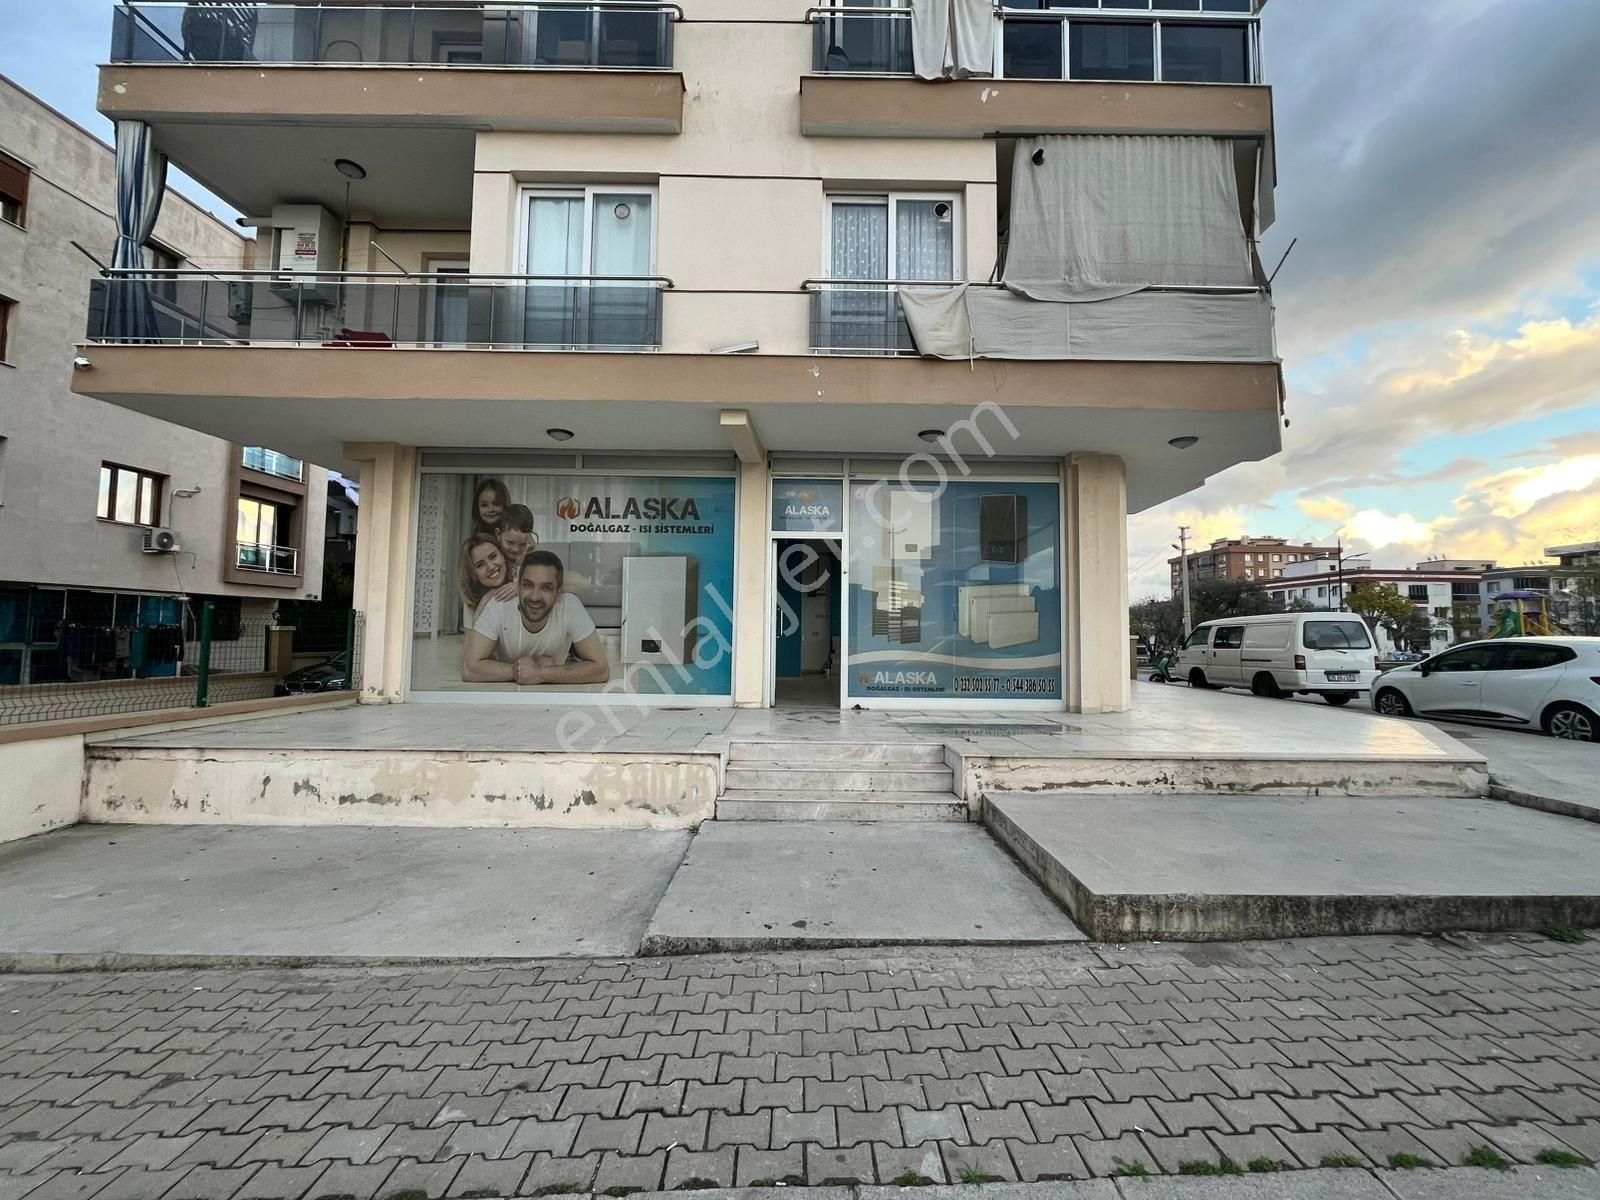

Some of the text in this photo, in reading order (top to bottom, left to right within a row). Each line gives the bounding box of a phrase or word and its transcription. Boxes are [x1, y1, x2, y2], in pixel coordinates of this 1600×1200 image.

[584, 496, 700, 520] ALASKA
[784, 505, 830, 515] ALASKA
[570, 522, 630, 533] DOĞALGAZ
[639, 524, 651, 533] ISI
[654, 523, 714, 534] SİSTEMLERİ
[874, 671, 937, 685] ALASKA
[954, 677, 959, 692] 0
[993, 678, 1000, 692] 77
[1006, 678, 1011, 692] 0
[1013, 678, 1024, 692] 544
[1025, 679, 1036, 692] 386
